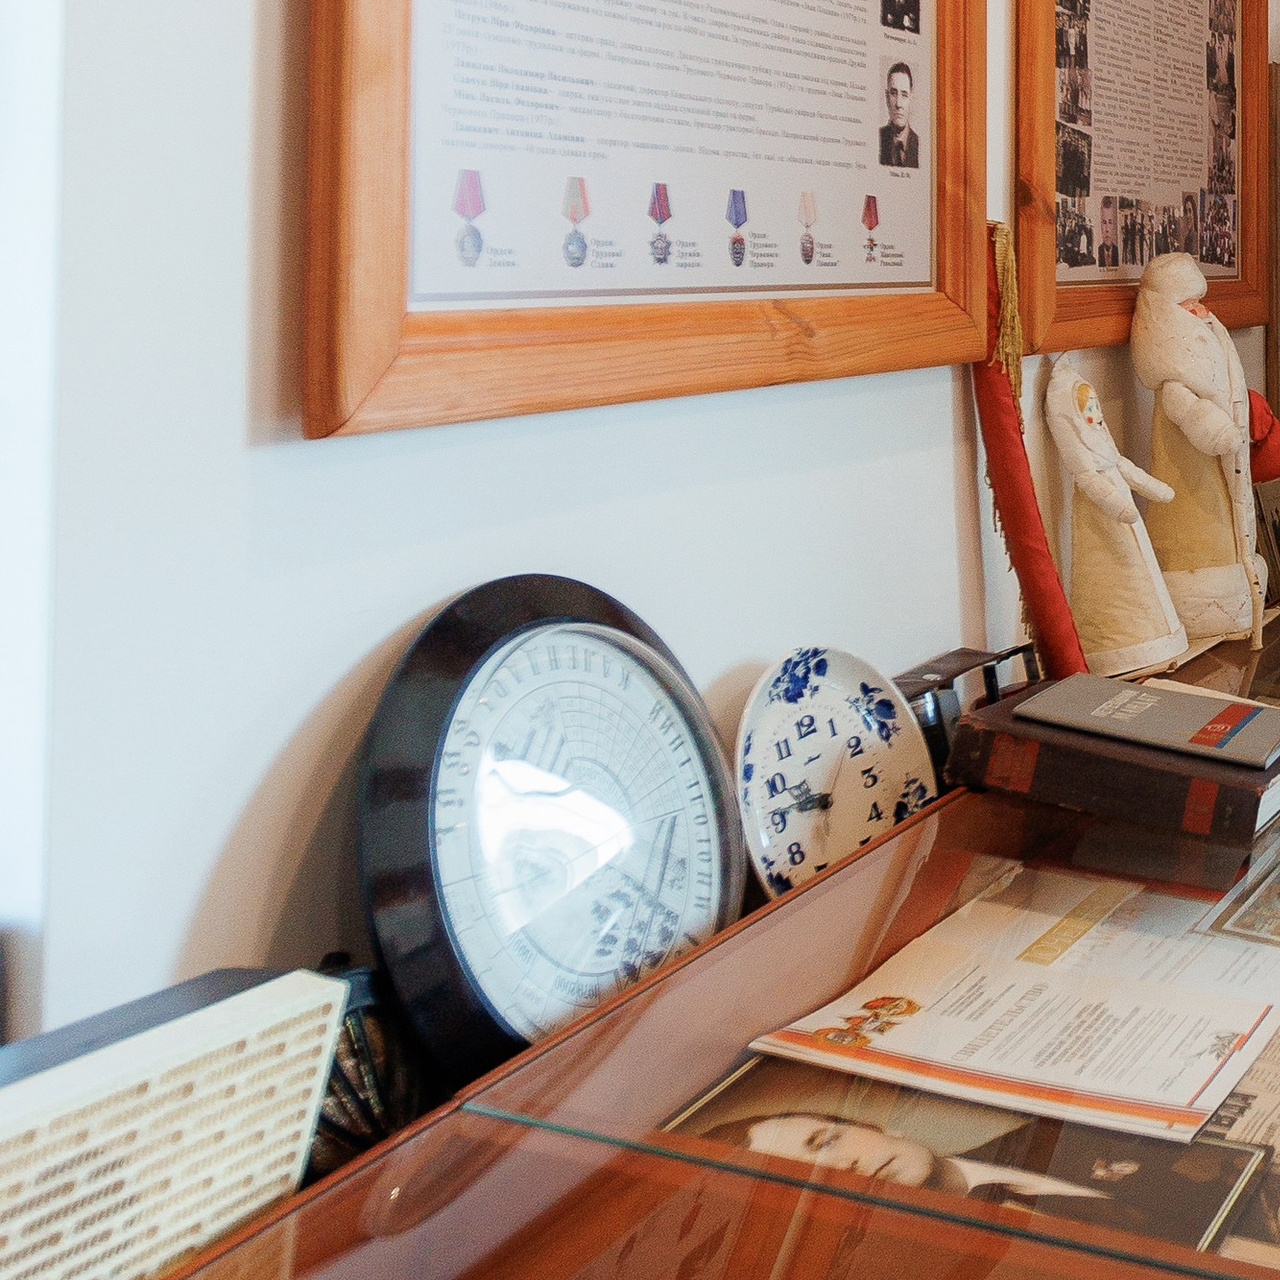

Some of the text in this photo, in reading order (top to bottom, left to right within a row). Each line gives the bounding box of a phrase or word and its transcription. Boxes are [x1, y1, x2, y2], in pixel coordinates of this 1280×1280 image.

[794, 714, 818, 741] 12
[826, 718, 839, 739] 1
[774, 739, 792, 762] 11
[847, 735, 864, 759] 2
[764, 772, 787, 800] 10
[861, 766, 879, 789] 3
[770, 810, 788, 834] 9
[867, 801, 884, 824] 4
[787, 842, 806, 866] 8
[952, 981, 1049, 1062] СВИДЕТЕЛЬСТВО
